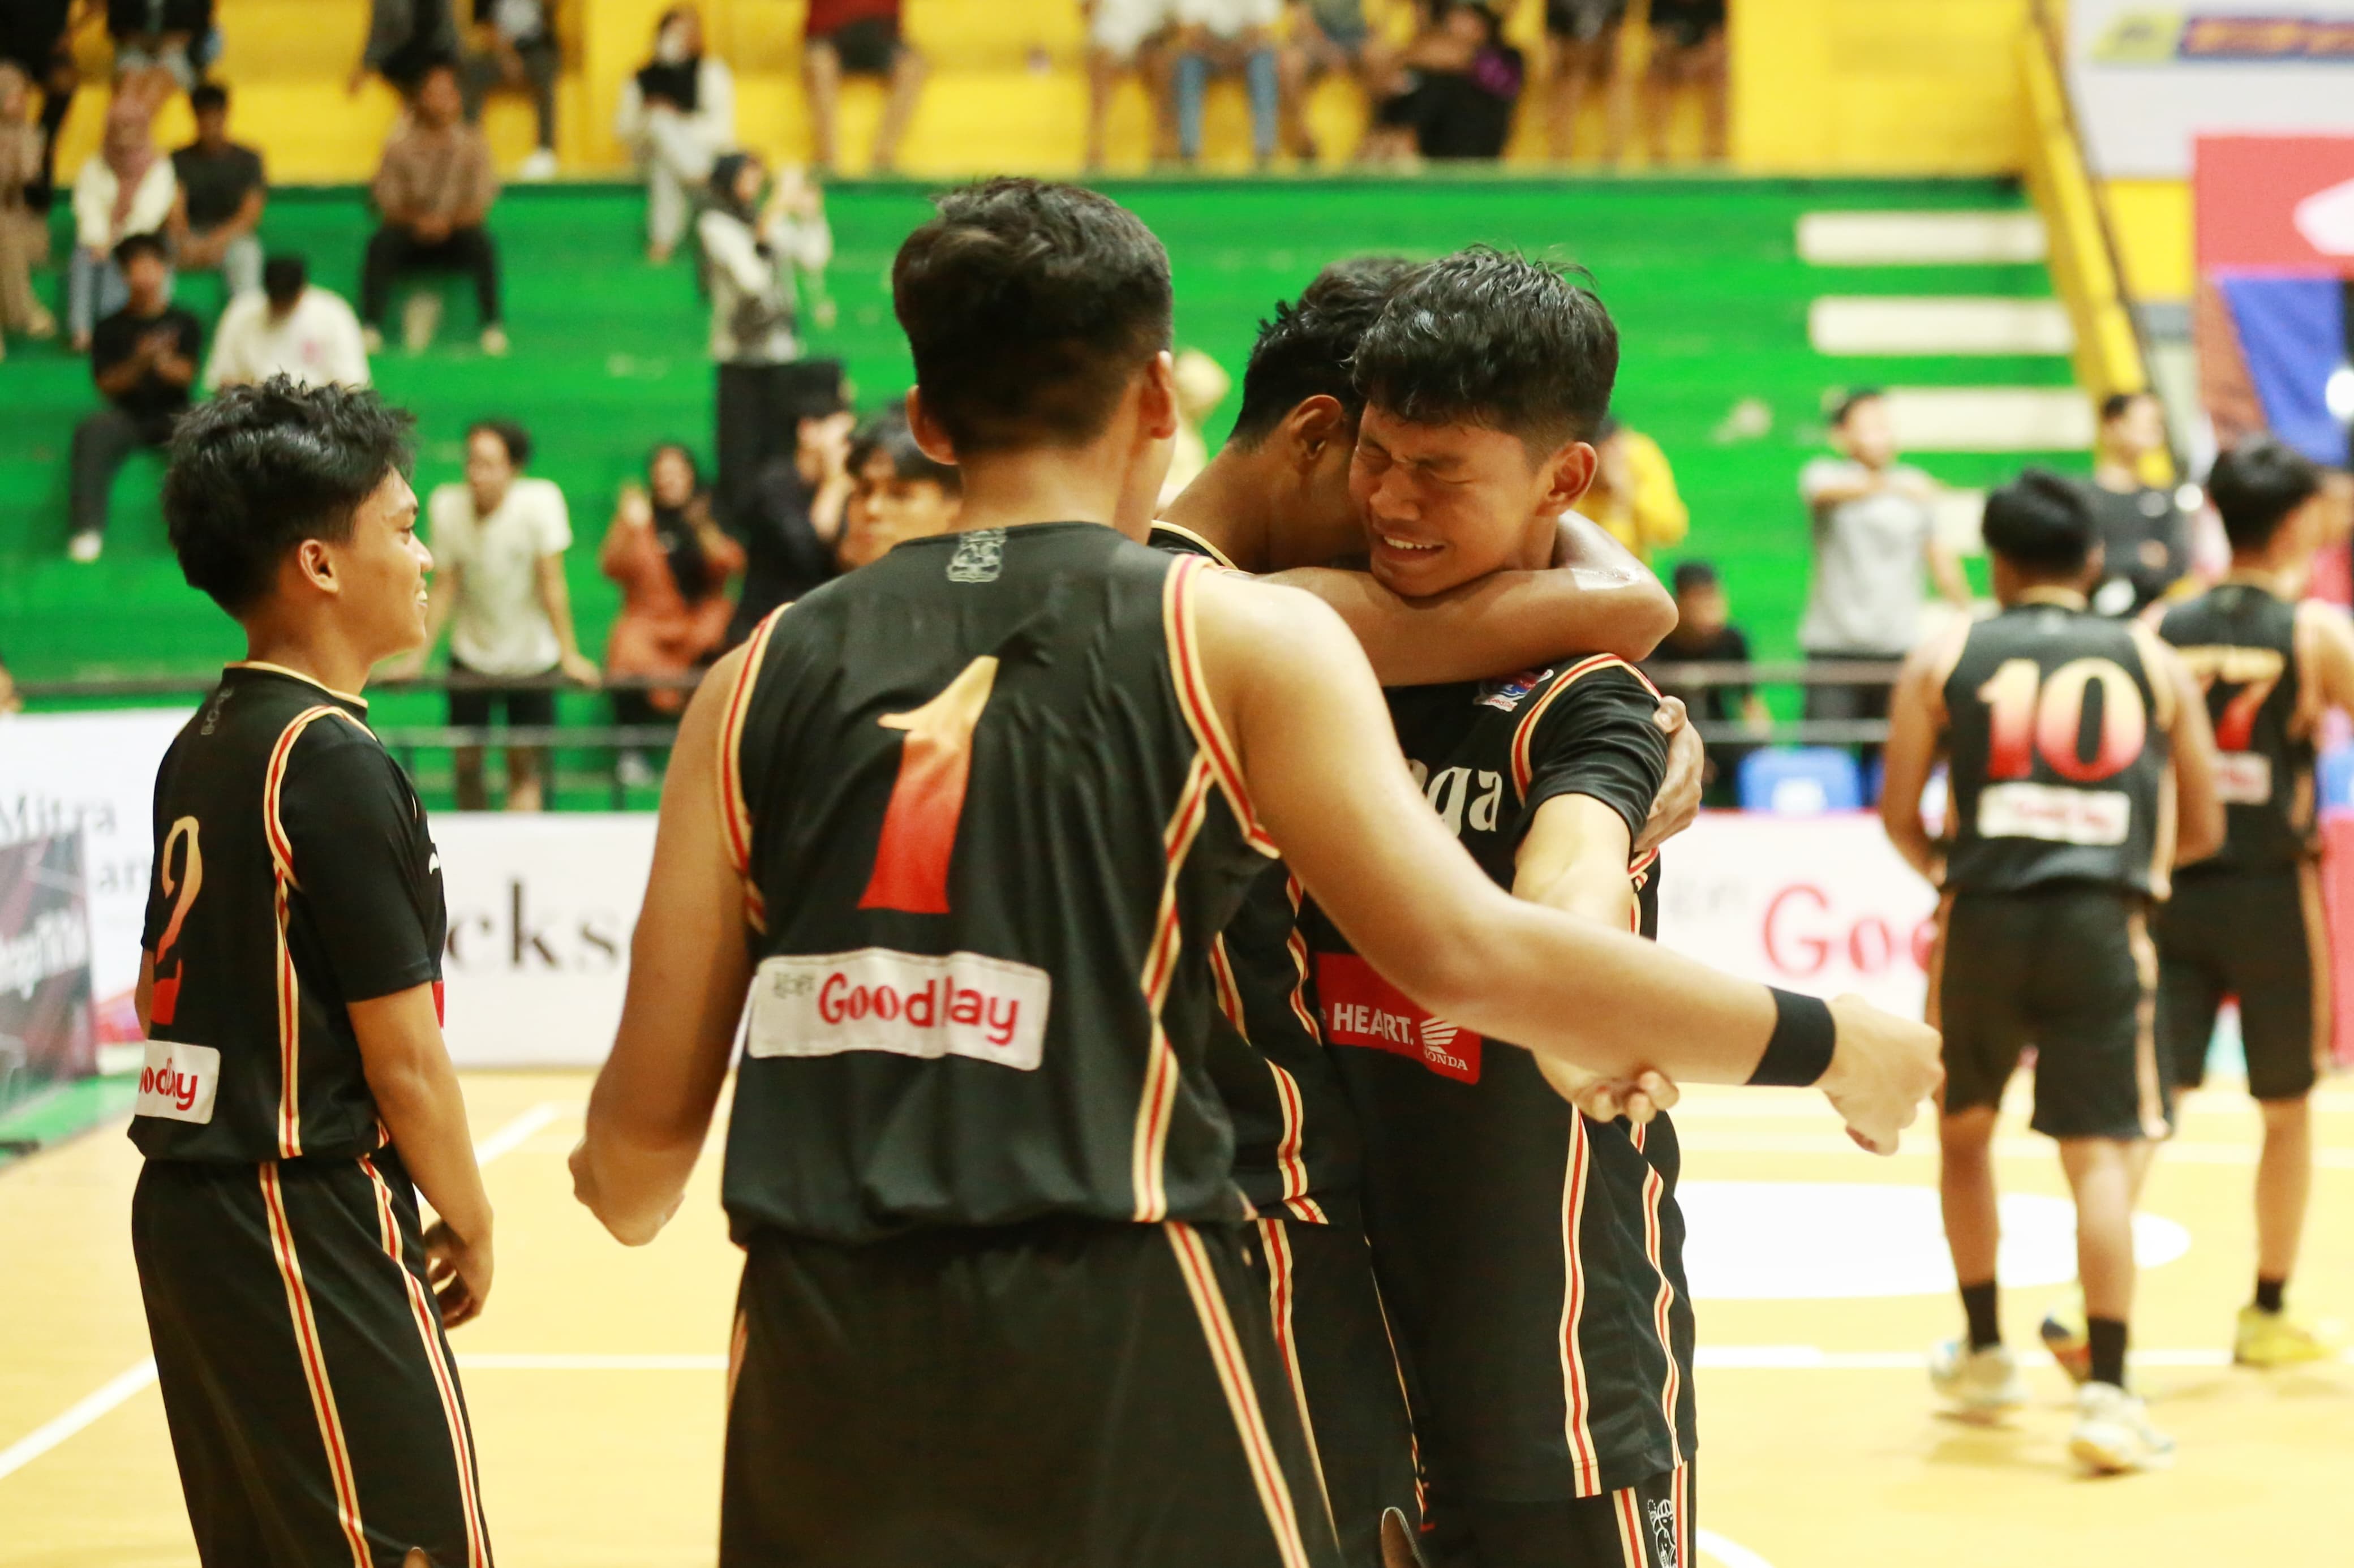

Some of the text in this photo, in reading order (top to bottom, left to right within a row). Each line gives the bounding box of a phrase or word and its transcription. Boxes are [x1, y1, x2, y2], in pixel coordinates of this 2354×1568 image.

[1977, 657, 2146, 782] 10
[2173, 645, 2284, 751] 7
[857, 655, 1000, 914] 1
[151, 815, 203, 1026] 2
[1333, 1002, 1414, 1045] HEART.
